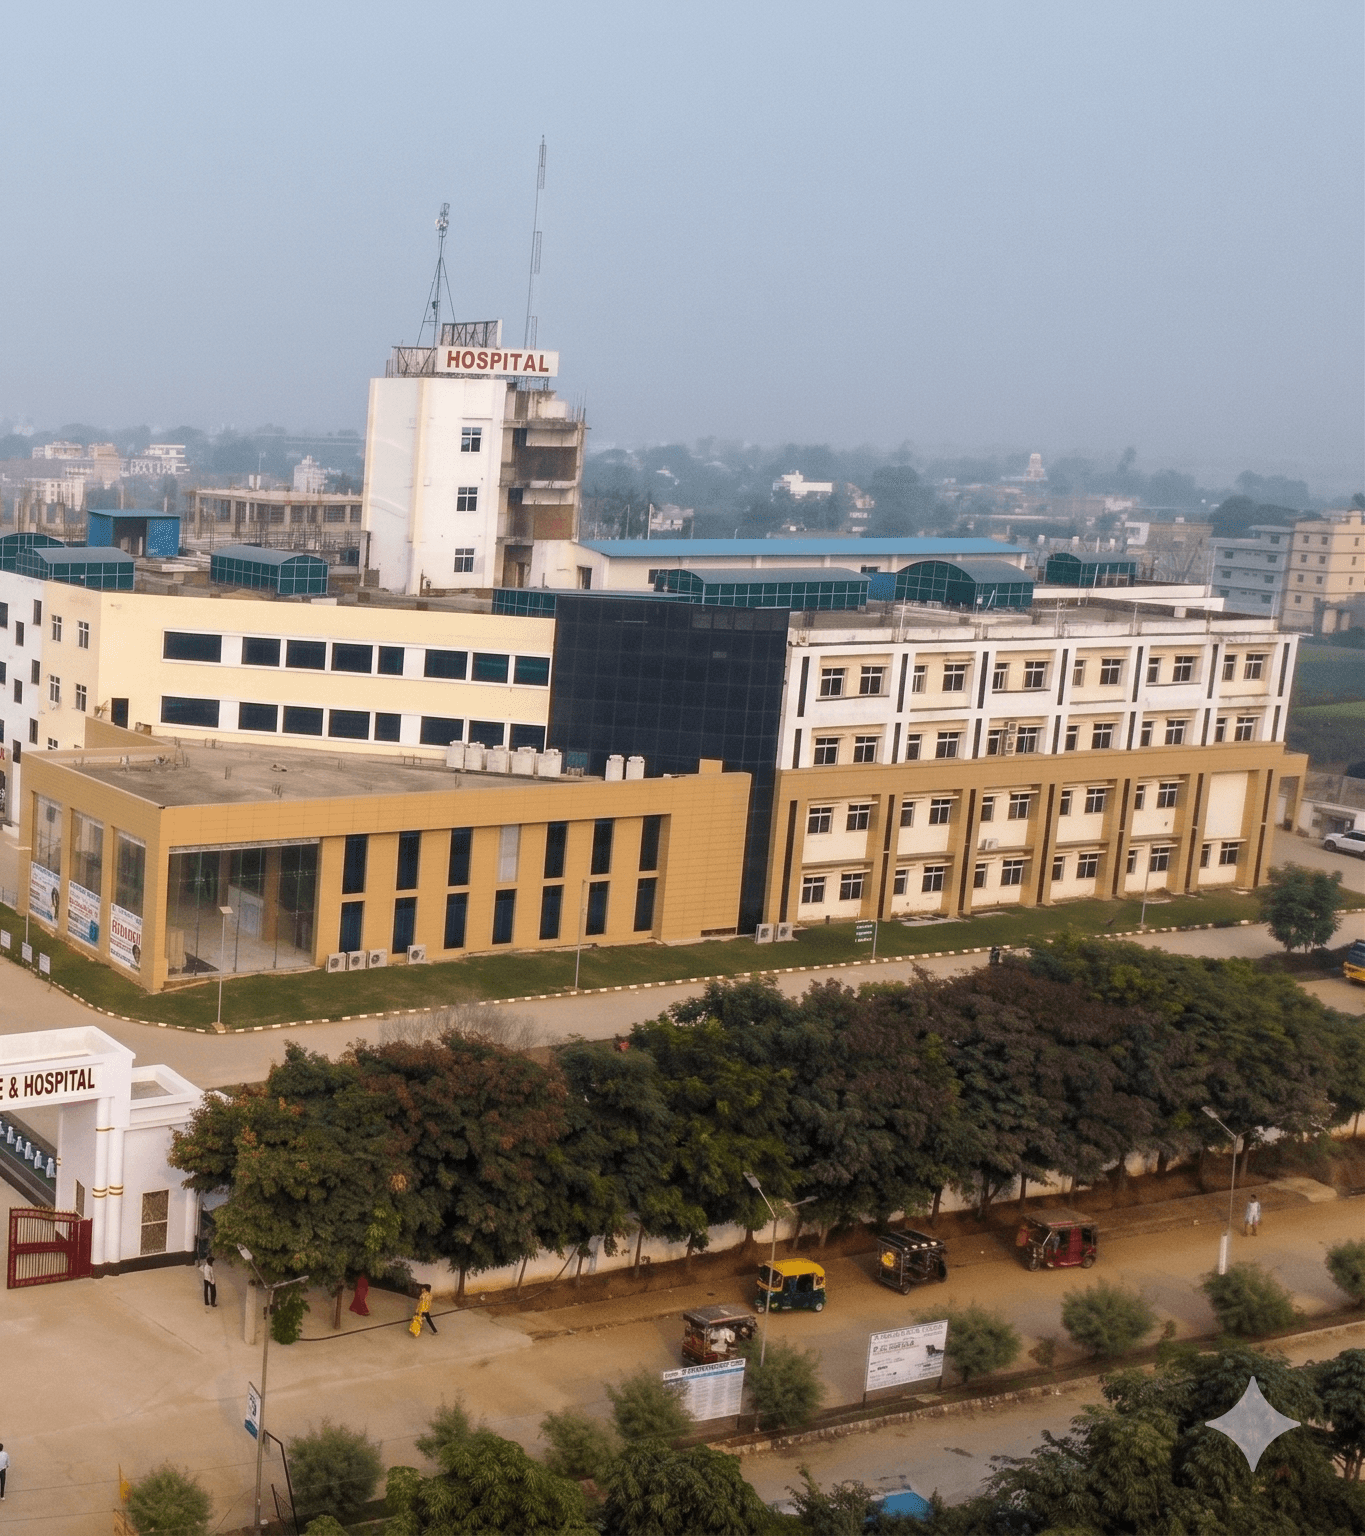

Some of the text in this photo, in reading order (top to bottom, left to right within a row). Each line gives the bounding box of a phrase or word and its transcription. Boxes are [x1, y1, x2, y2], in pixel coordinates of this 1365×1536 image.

[446, 350, 549, 373] HOSPITAL
[8, 1076, 19, 1099] &
[24, 1067, 95, 1097] HOSPITAL
